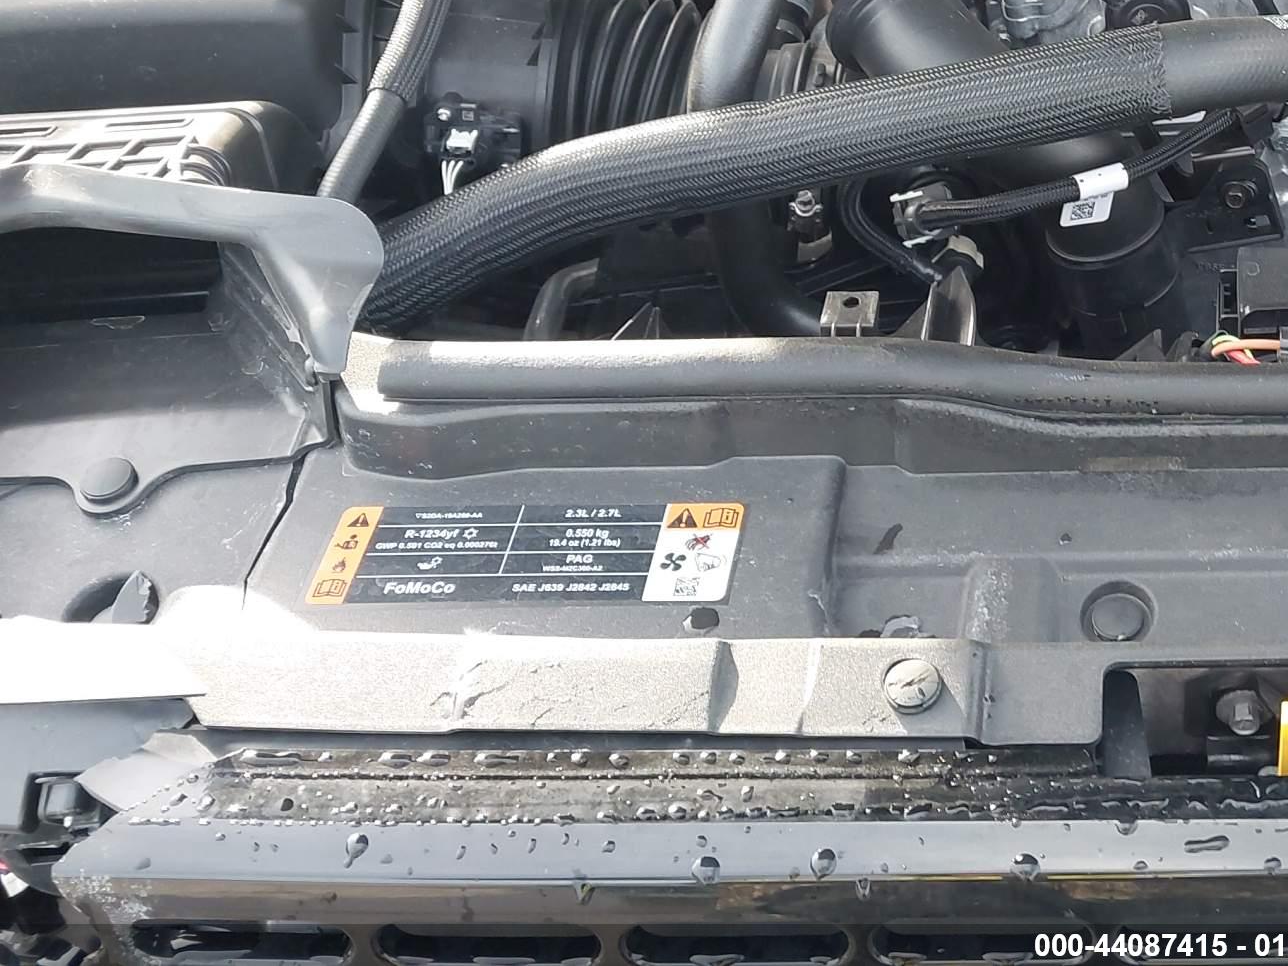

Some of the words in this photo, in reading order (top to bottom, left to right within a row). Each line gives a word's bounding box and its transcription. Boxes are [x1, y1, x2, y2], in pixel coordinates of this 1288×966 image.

[565, 508, 589, 518] 2.3L
[598, 508, 622, 518] 2.7L
[404, 529, 460, 540] R-1234yf
[565, 528, 594, 538] 0.550
[595, 528, 610, 539] kg
[375, 542, 397, 550] GWP
[549, 538, 567, 547] 19.4
[581, 538, 602, 548] (1.21
[603, 537, 621, 548] lbs)
[566, 553, 594, 564] PAG
[383, 580, 456, 595] FoMoCo
[512, 583, 536, 592] SAE
[538, 583, 564, 592] J639
[566, 583, 597, 592] J2842
